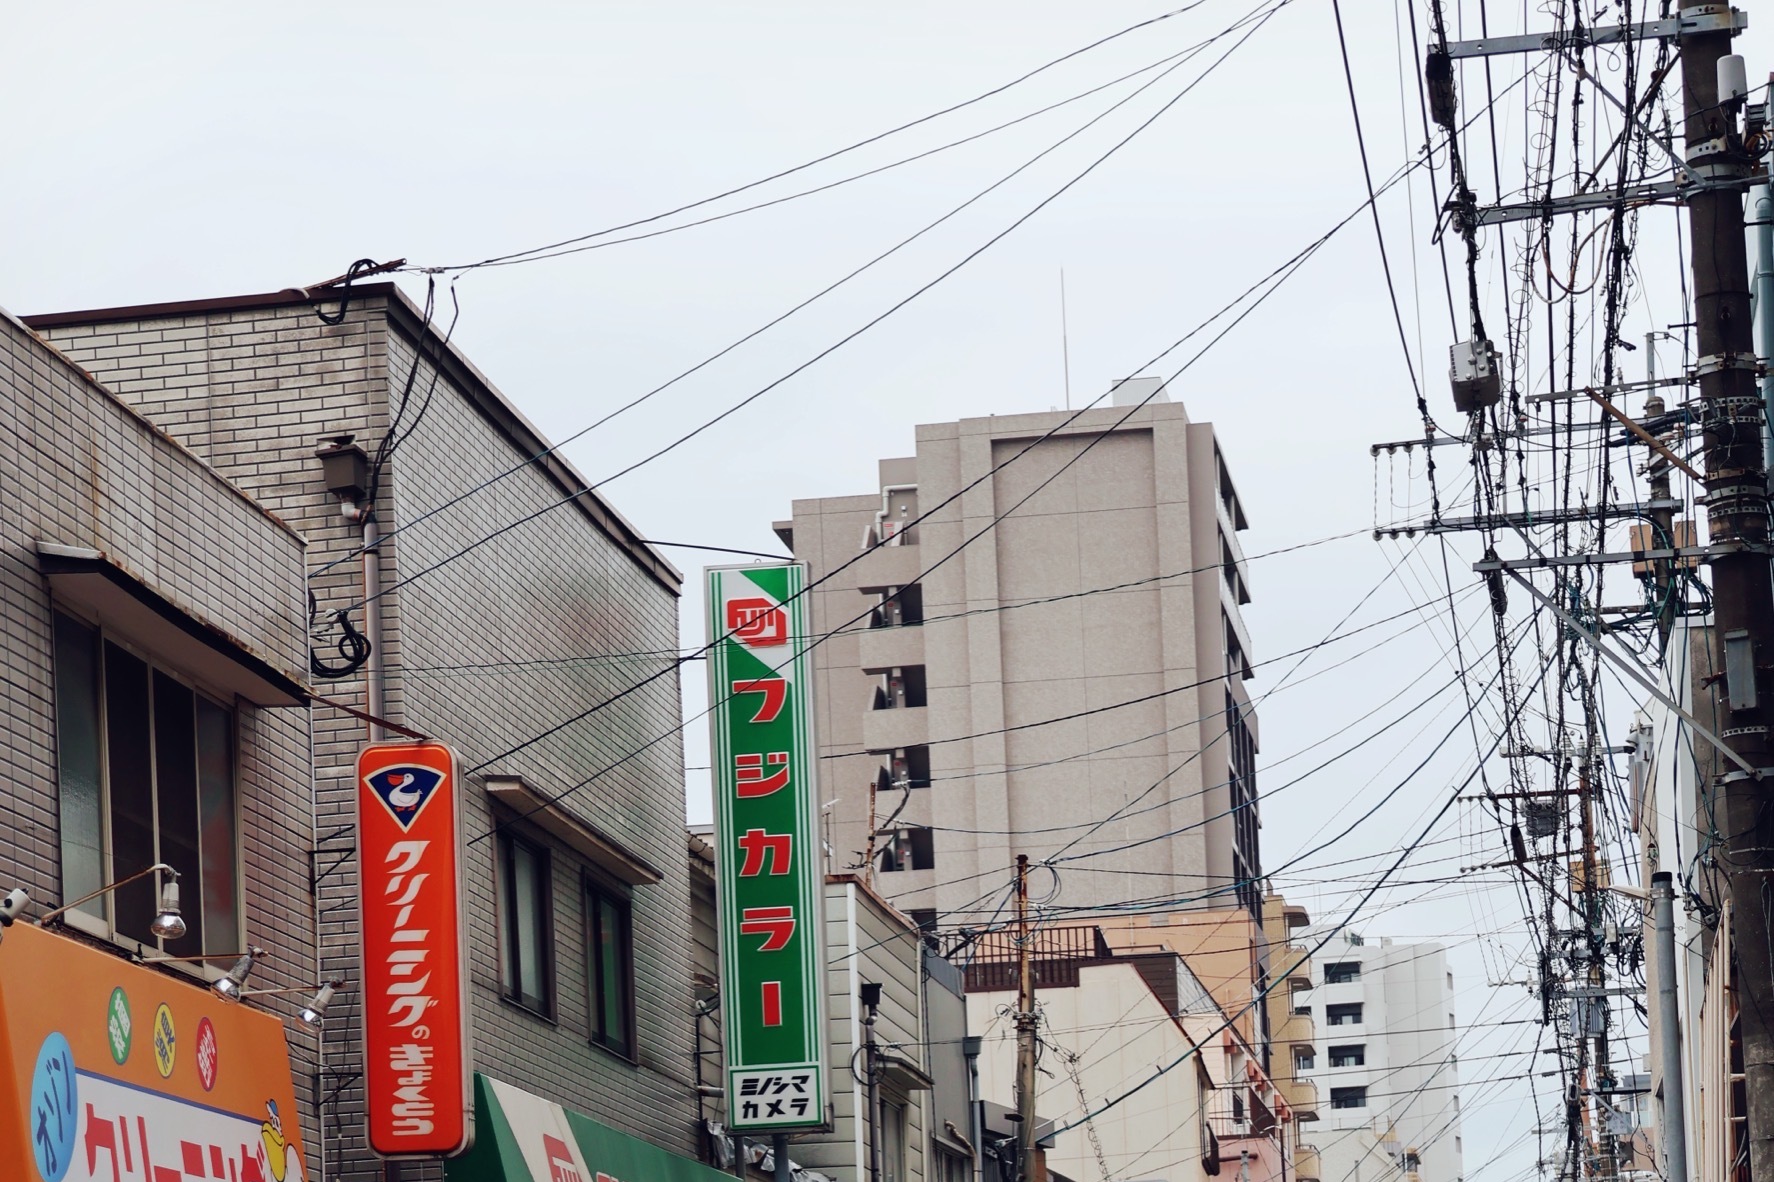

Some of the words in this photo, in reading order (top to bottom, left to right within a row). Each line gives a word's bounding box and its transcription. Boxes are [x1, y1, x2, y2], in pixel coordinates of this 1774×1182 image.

[732, 677, 796, 1027] フジカラー
[37, 1051, 71, 1176] オゾン
[740, 1075, 809, 1095] ミノシマ
[741, 1098, 809, 1119] カメラ
